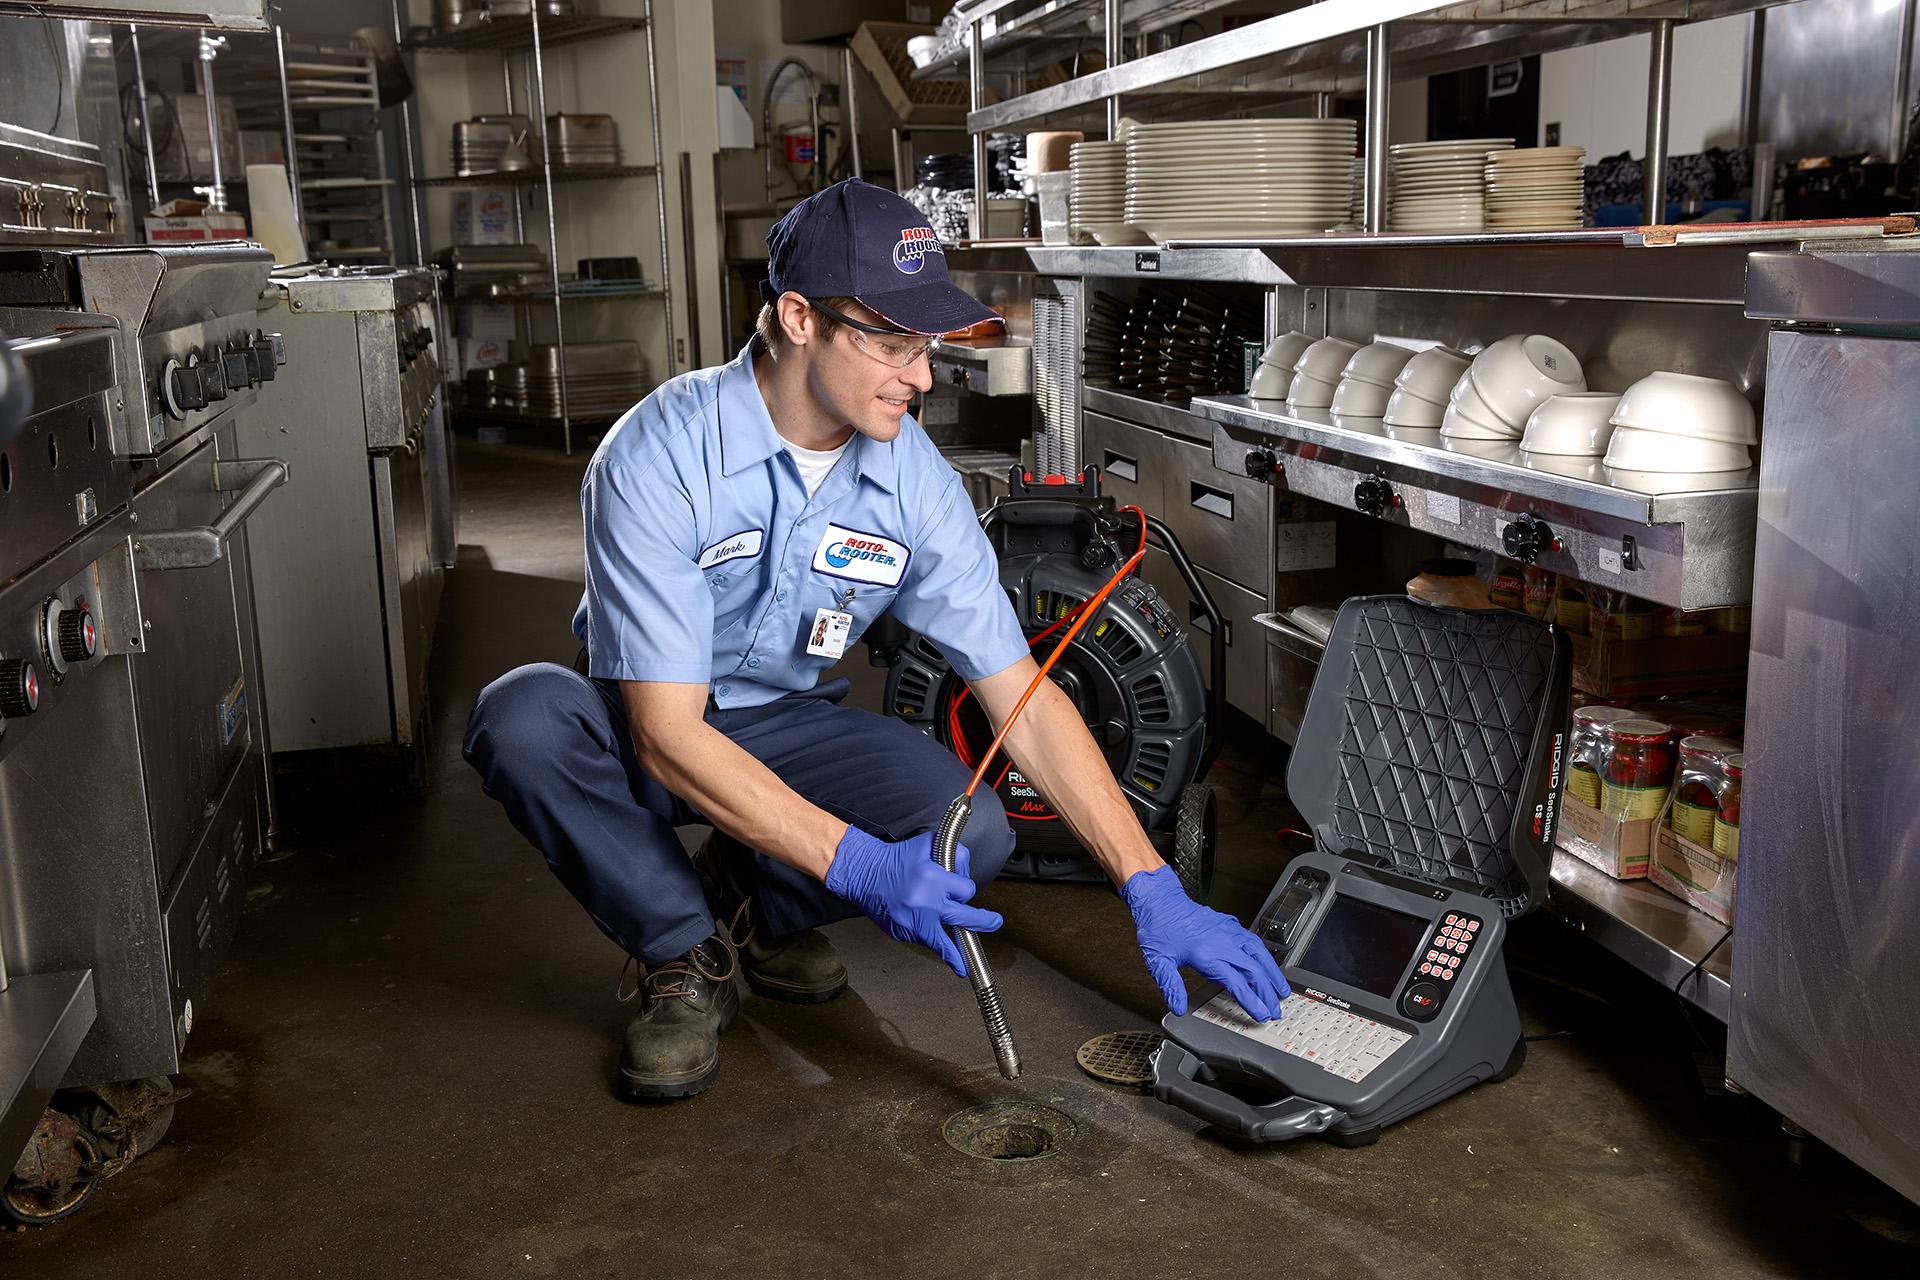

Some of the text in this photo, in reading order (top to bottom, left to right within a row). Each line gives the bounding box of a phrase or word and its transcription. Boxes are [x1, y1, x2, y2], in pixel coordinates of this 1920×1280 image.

[905, 239, 943, 255] ROOTE
[711, 541, 746, 562] Mark
[845, 537, 888, 553] ROTO-
[1542, 733, 1563, 843] RIDGID SeeSnake
[1304, 986, 1351, 1010] RIDGID SeeSnake
